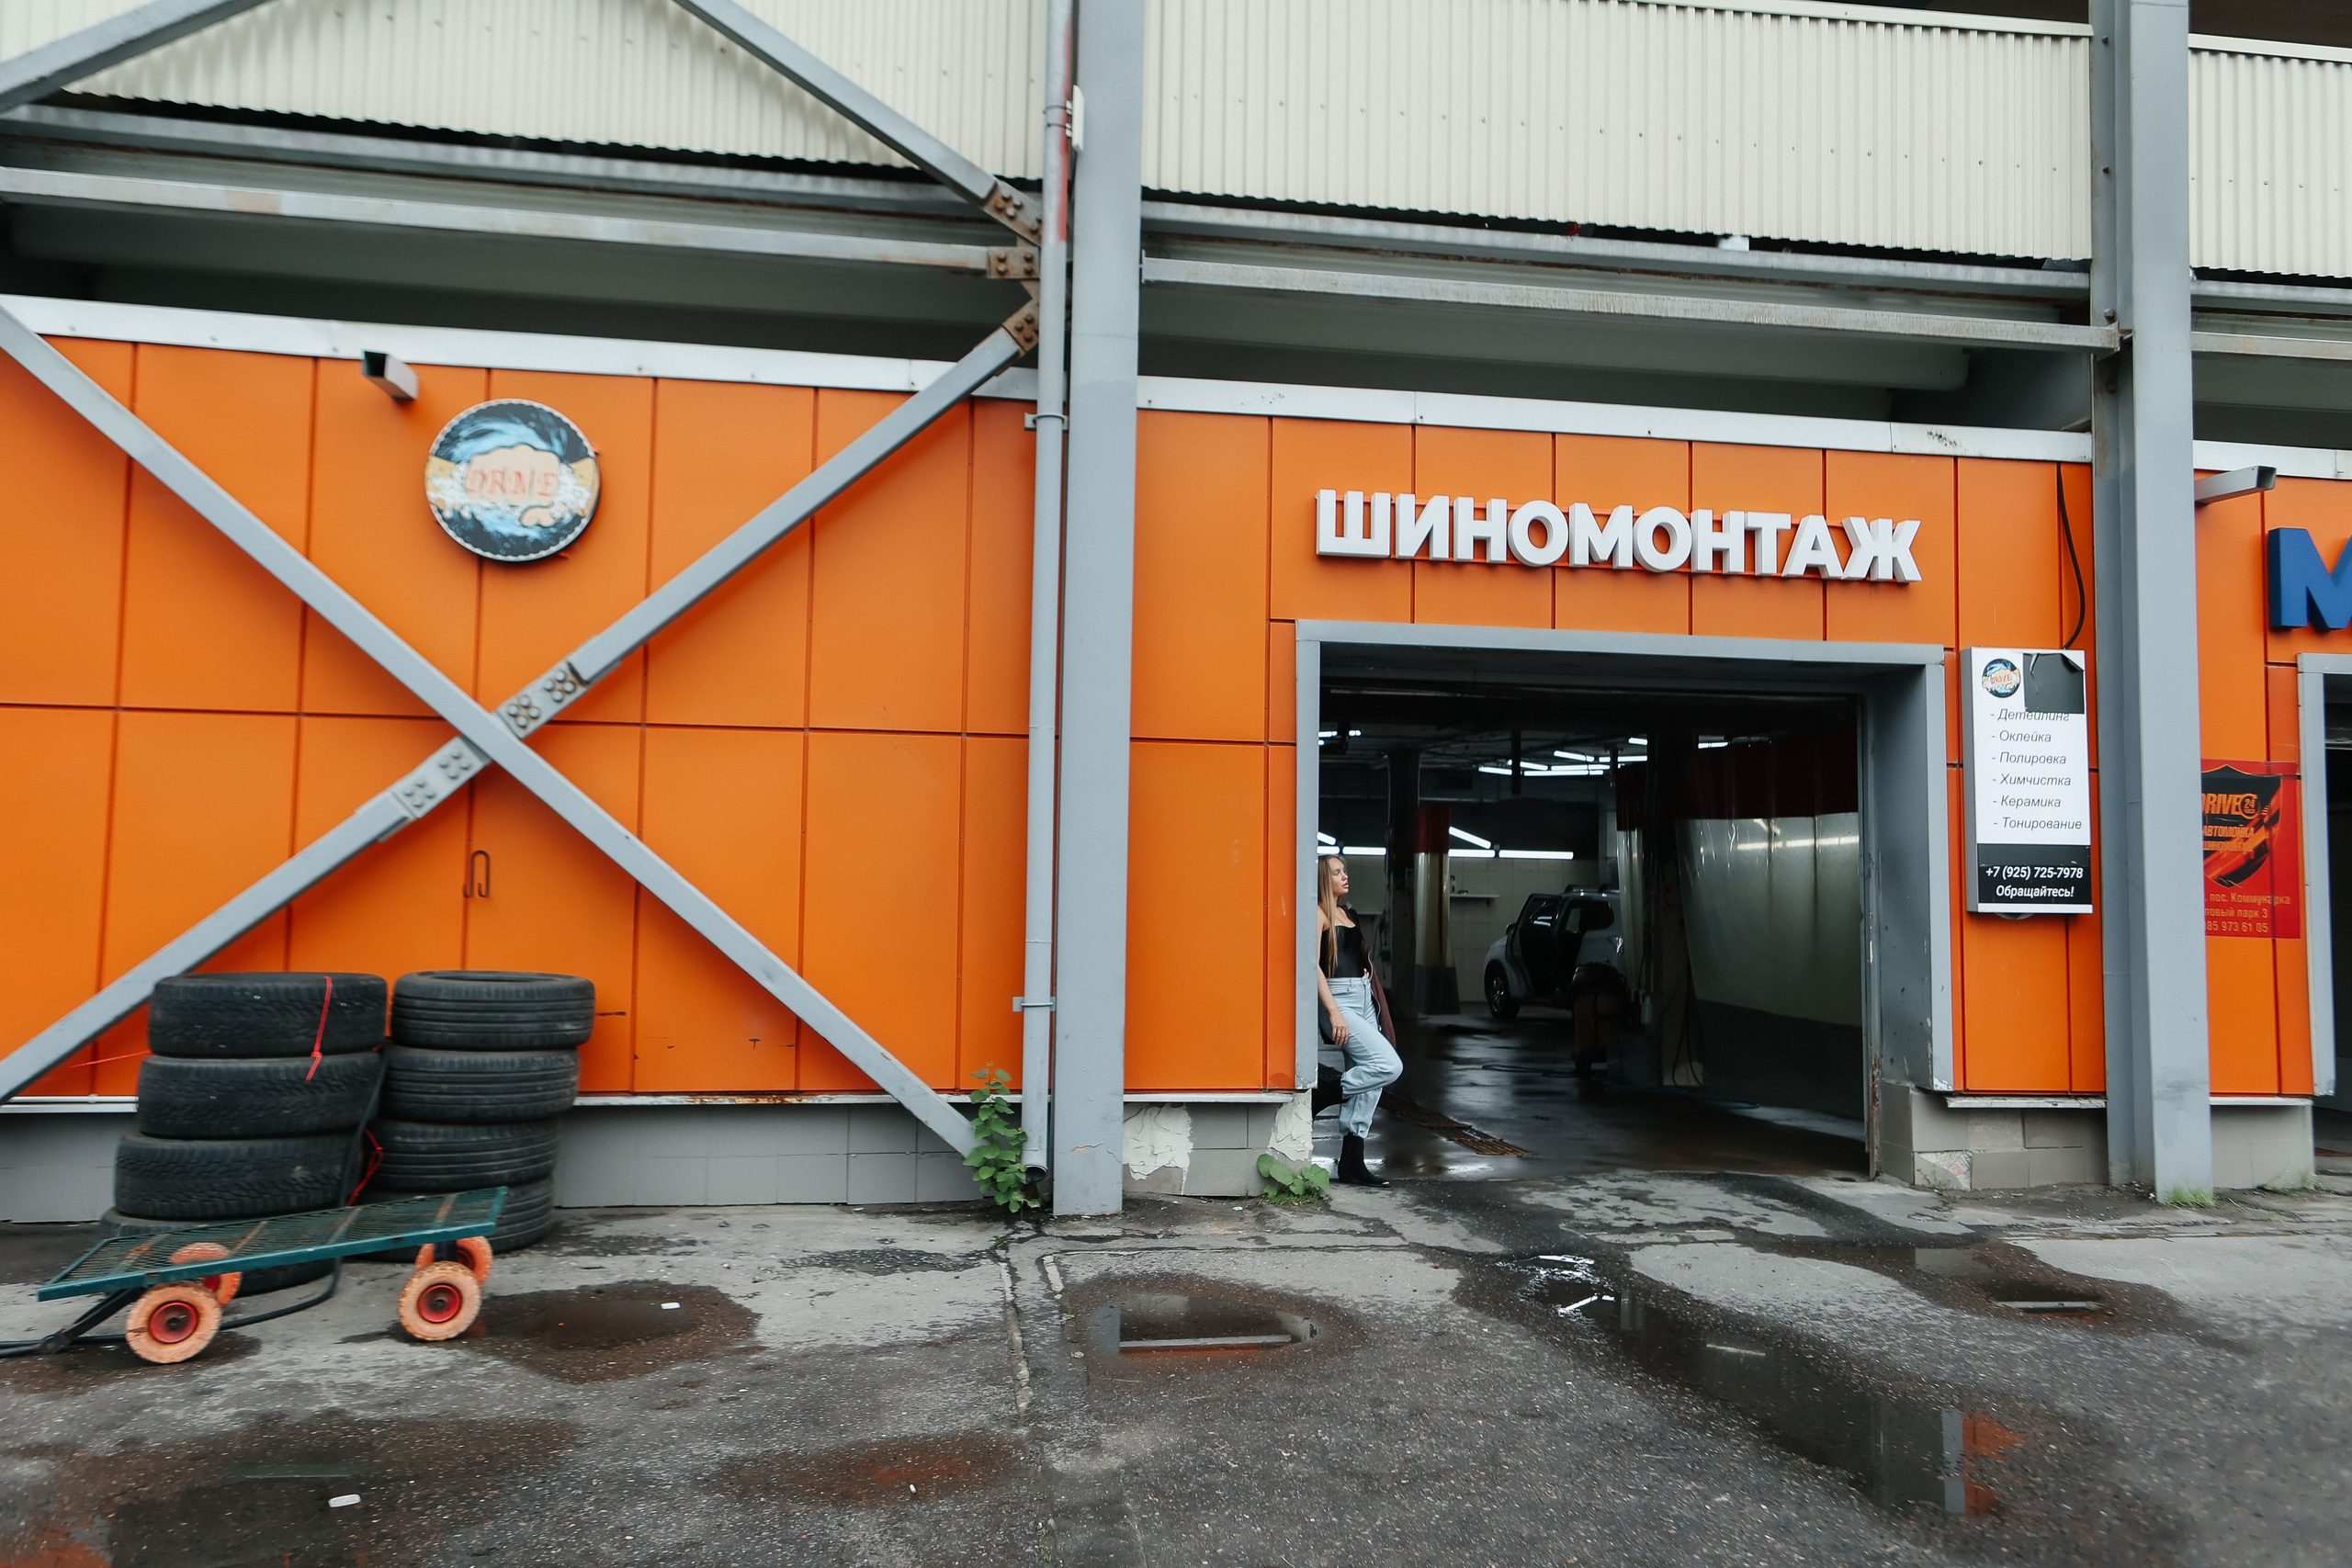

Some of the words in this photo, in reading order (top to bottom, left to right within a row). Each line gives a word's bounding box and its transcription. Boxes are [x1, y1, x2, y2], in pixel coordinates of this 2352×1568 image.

[1316, 489, 1922, 582] ШИНОМОНТАЖ
[1991, 673, 2012, 684] DRIVE
[1999, 730, 2052, 742] Оклейка
[1999, 751, 2066, 766] Полировка
[1999, 773, 2071, 786] Химчистка
[2000, 795, 2061, 809] Керамика
[2002, 817, 2082, 831] Тонирование
[1985, 866, 2000, 878] +7
[2002, 865, 2031, 881] (925)
[2033, 867, 2084, 879] 725-7978
[1996, 885, 2075, 899] Обращайтесь!
[2210, 893, 2229, 903] пос.
[2205, 907, 2234, 917] повый
[2236, 908, 2259, 919] парк
[2261, 908, 2268, 919] 3
[2206, 920, 2219, 931] 85
[2222, 921, 2239, 931] 973
[2241, 922, 2253, 932] 61
[2256, 922, 2268, 933] 05
